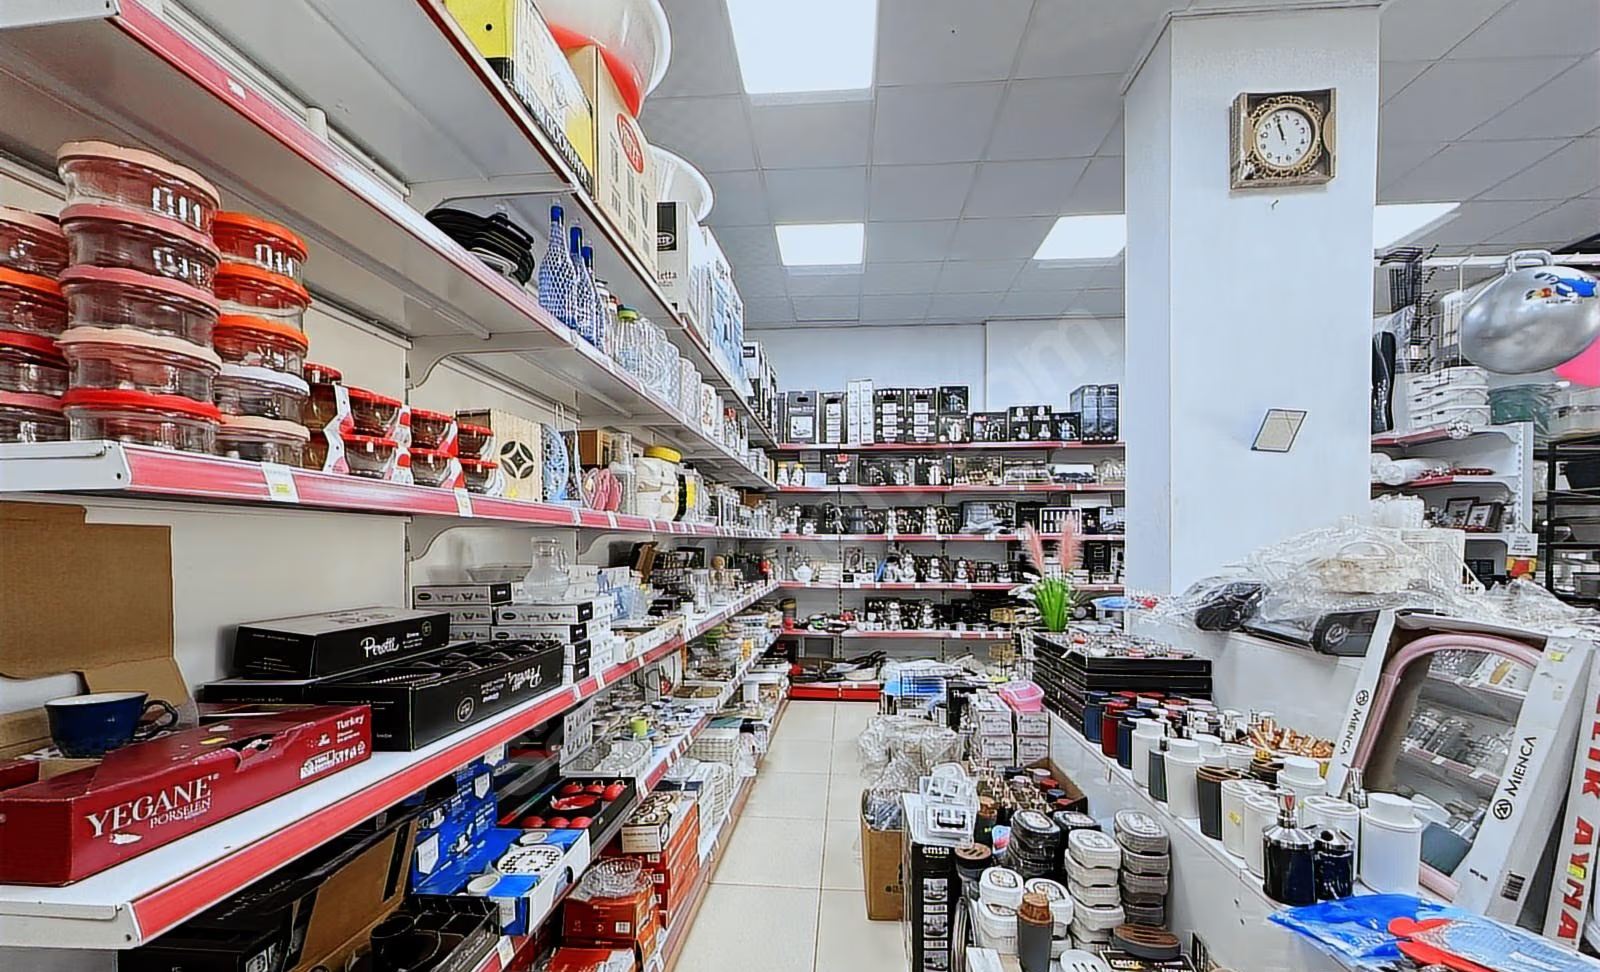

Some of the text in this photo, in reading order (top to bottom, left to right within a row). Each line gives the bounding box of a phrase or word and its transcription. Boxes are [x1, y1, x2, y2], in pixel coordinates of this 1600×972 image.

[1340, 708, 1362, 755] MIENCA
[1504, 735, 1537, 797] MIENCA
[86, 775, 213, 838] YEGANE
[150, 797, 212, 829] PORSELEN
[922, 846, 950, 855] emsa
[1557, 815, 1594, 940] AYNA
